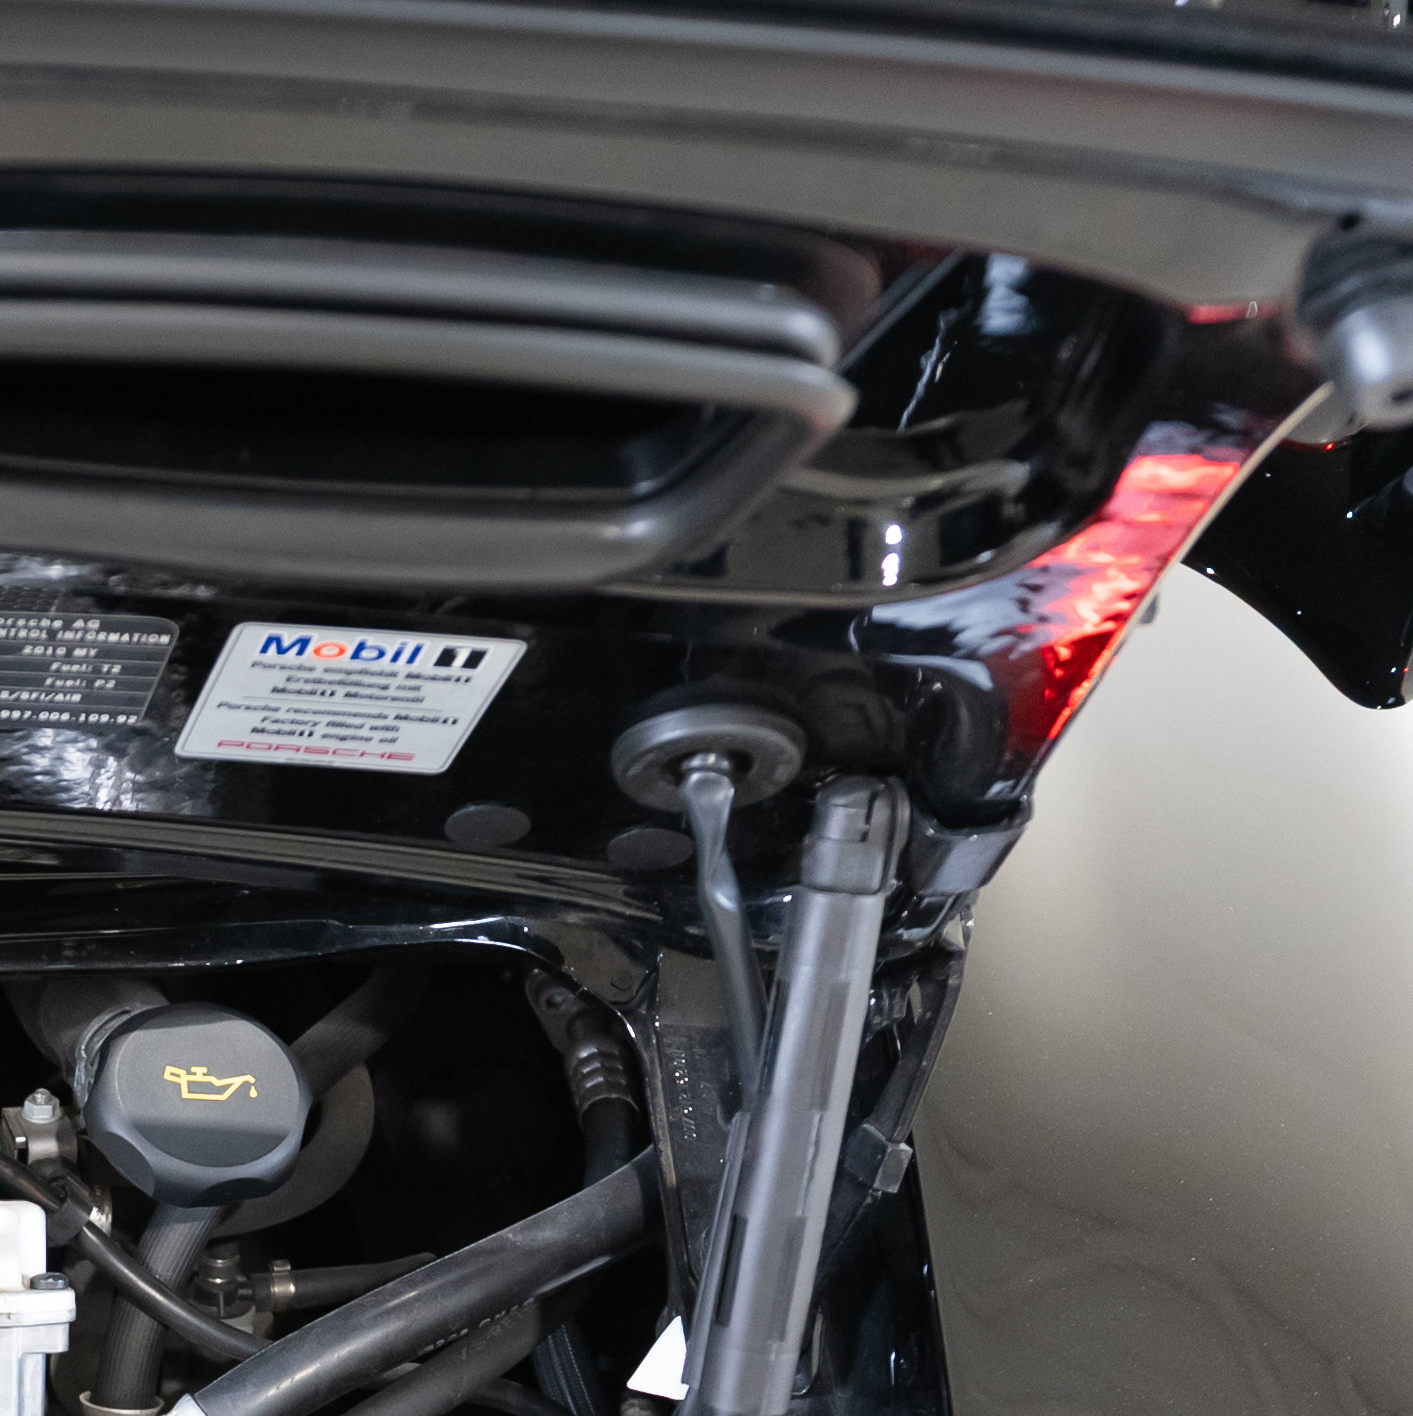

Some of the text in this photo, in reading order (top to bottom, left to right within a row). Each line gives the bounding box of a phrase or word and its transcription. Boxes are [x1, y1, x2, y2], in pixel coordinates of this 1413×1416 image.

[72, 619, 100, 630] AG
[55, 630, 171, 645] INFORMATION
[22, 645, 67, 657] 2010
[72, 647, 98, 658] MY
[259, 633, 424, 665] Mobil
[49, 662, 93, 673] Fuel:
[101, 663, 122, 675] T2
[251, 659, 317, 673] Porsche
[44, 677, 87, 688] Fuel:
[94, 679, 116, 690] P2
[217, 700, 282, 713] Porsche
[286, 707, 389, 720] recommends
[261, 714, 401, 732] Factory filled with
[321, 731, 373, 743] engine
[379, 735, 399, 744] oil
[217, 739, 415, 762] PORSCHE
